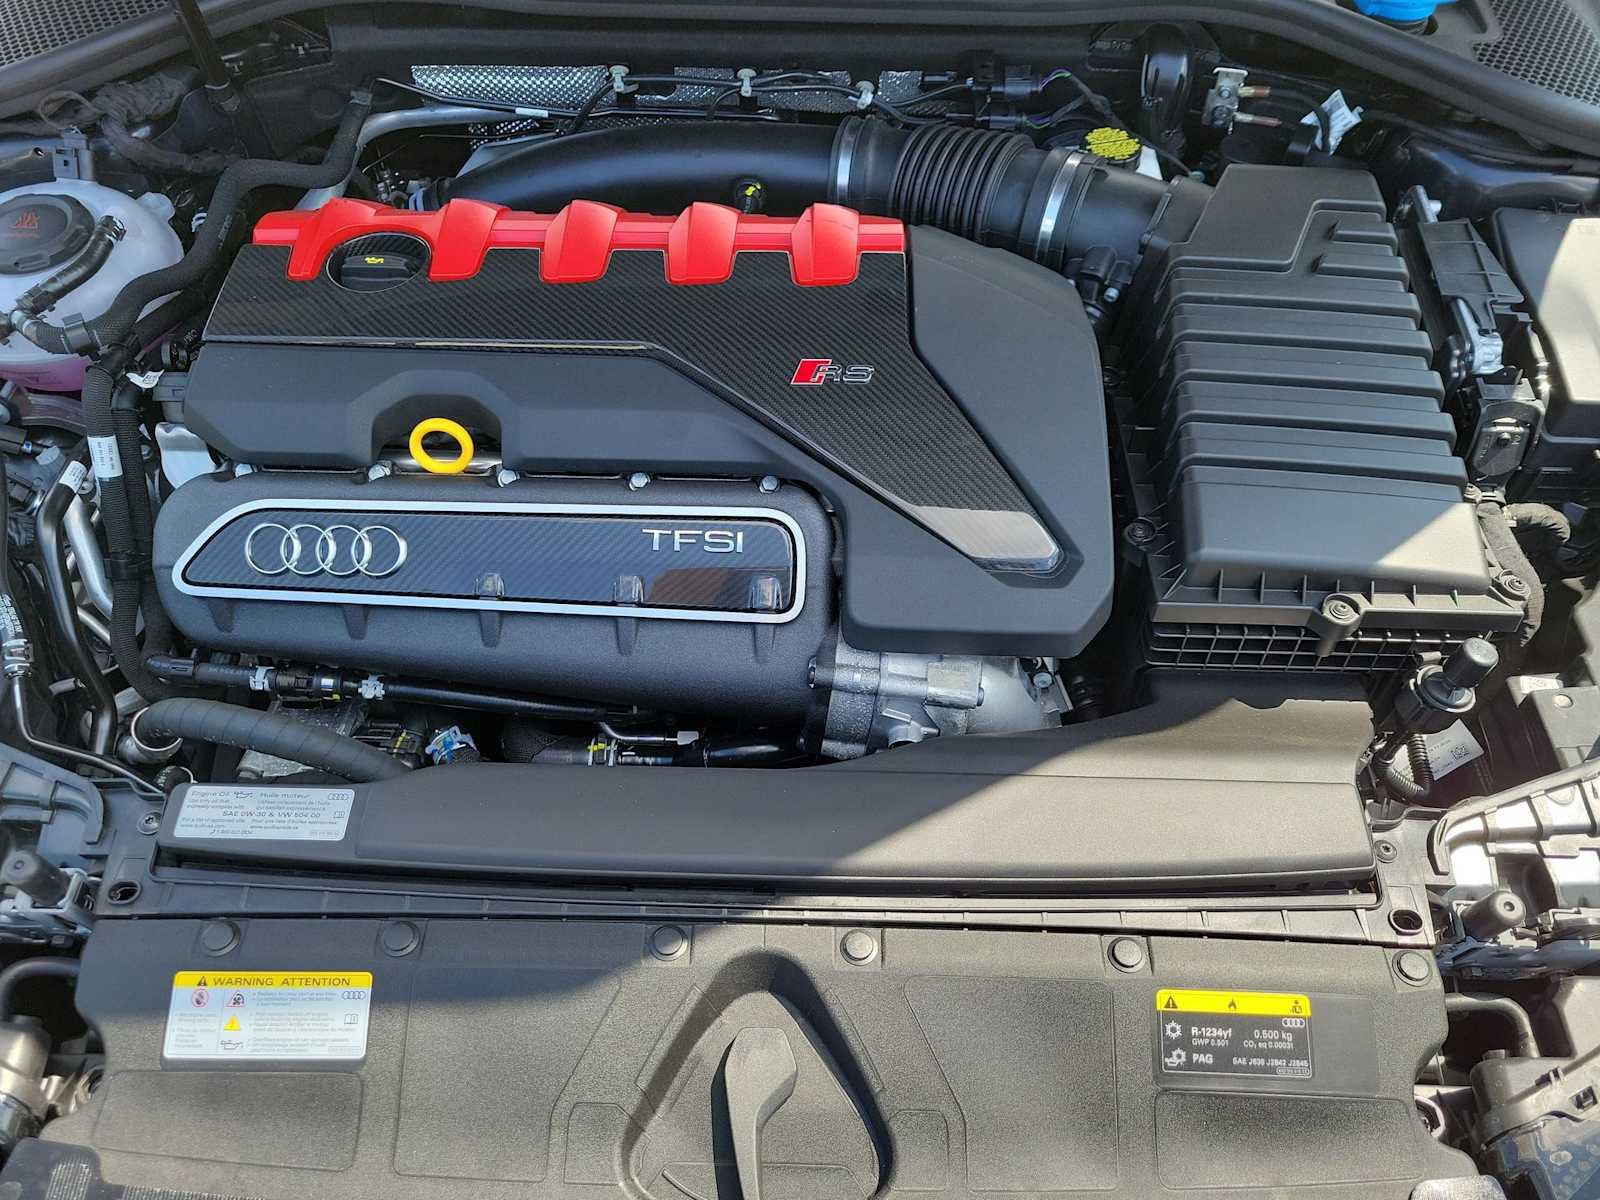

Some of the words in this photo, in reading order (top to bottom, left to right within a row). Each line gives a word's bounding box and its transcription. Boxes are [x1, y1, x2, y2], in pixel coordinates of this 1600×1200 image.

[808, 362, 875, 385] RS
[641, 528, 744, 553] TFSI
[213, 977, 273, 986] WARNING
[282, 977, 351, 987] ATTENTION
[1191, 1026, 1232, 1040] R-1234yf
[1281, 1030, 1293, 1042] kg
[1191, 1038, 1210, 1046] GWP
[1192, 1053, 1213, 1064] PAG
